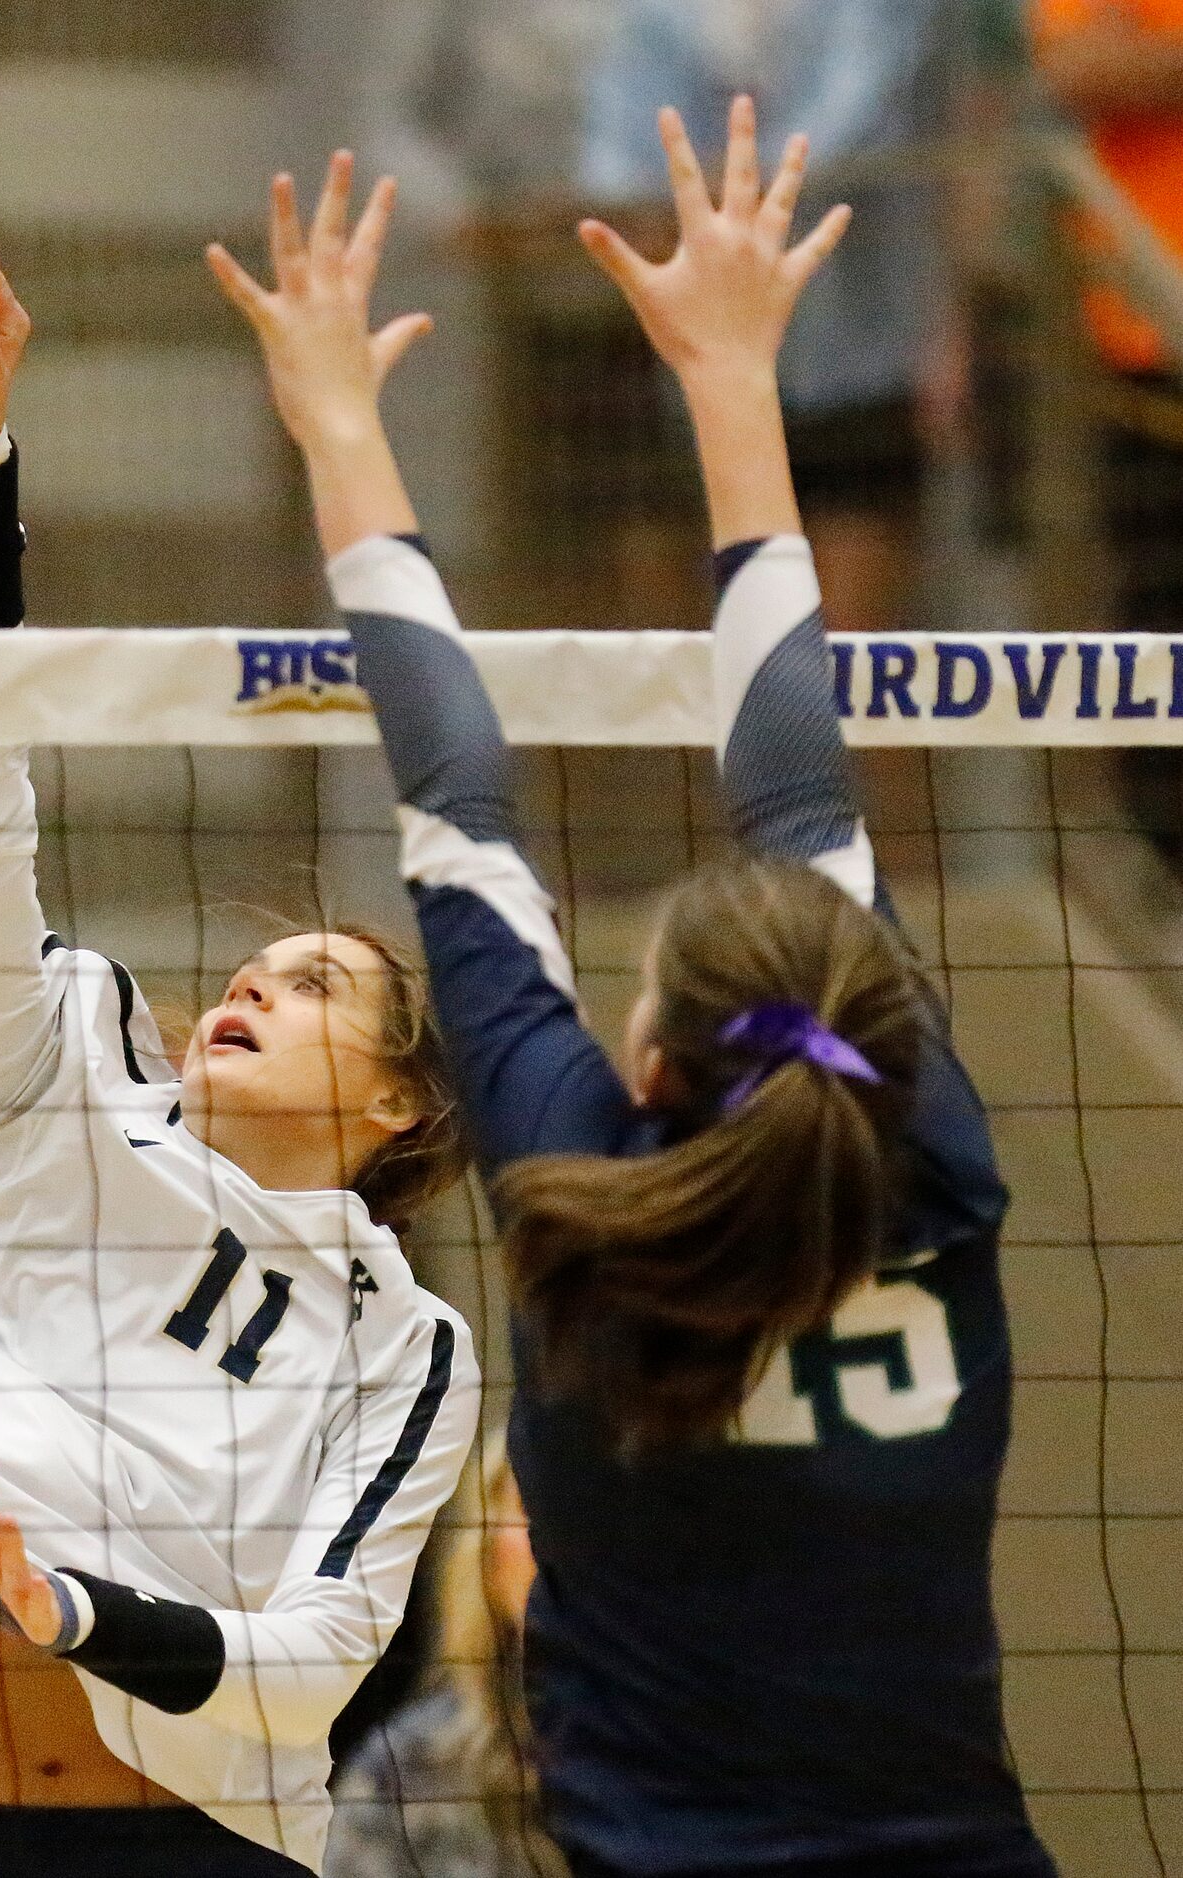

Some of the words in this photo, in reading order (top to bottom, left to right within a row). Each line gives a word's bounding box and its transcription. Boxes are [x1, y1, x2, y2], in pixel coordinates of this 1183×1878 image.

[236, 641, 357, 701] BIS
[832, 642, 1183, 719] IRDVIL
[163, 1227, 294, 1384] 11
